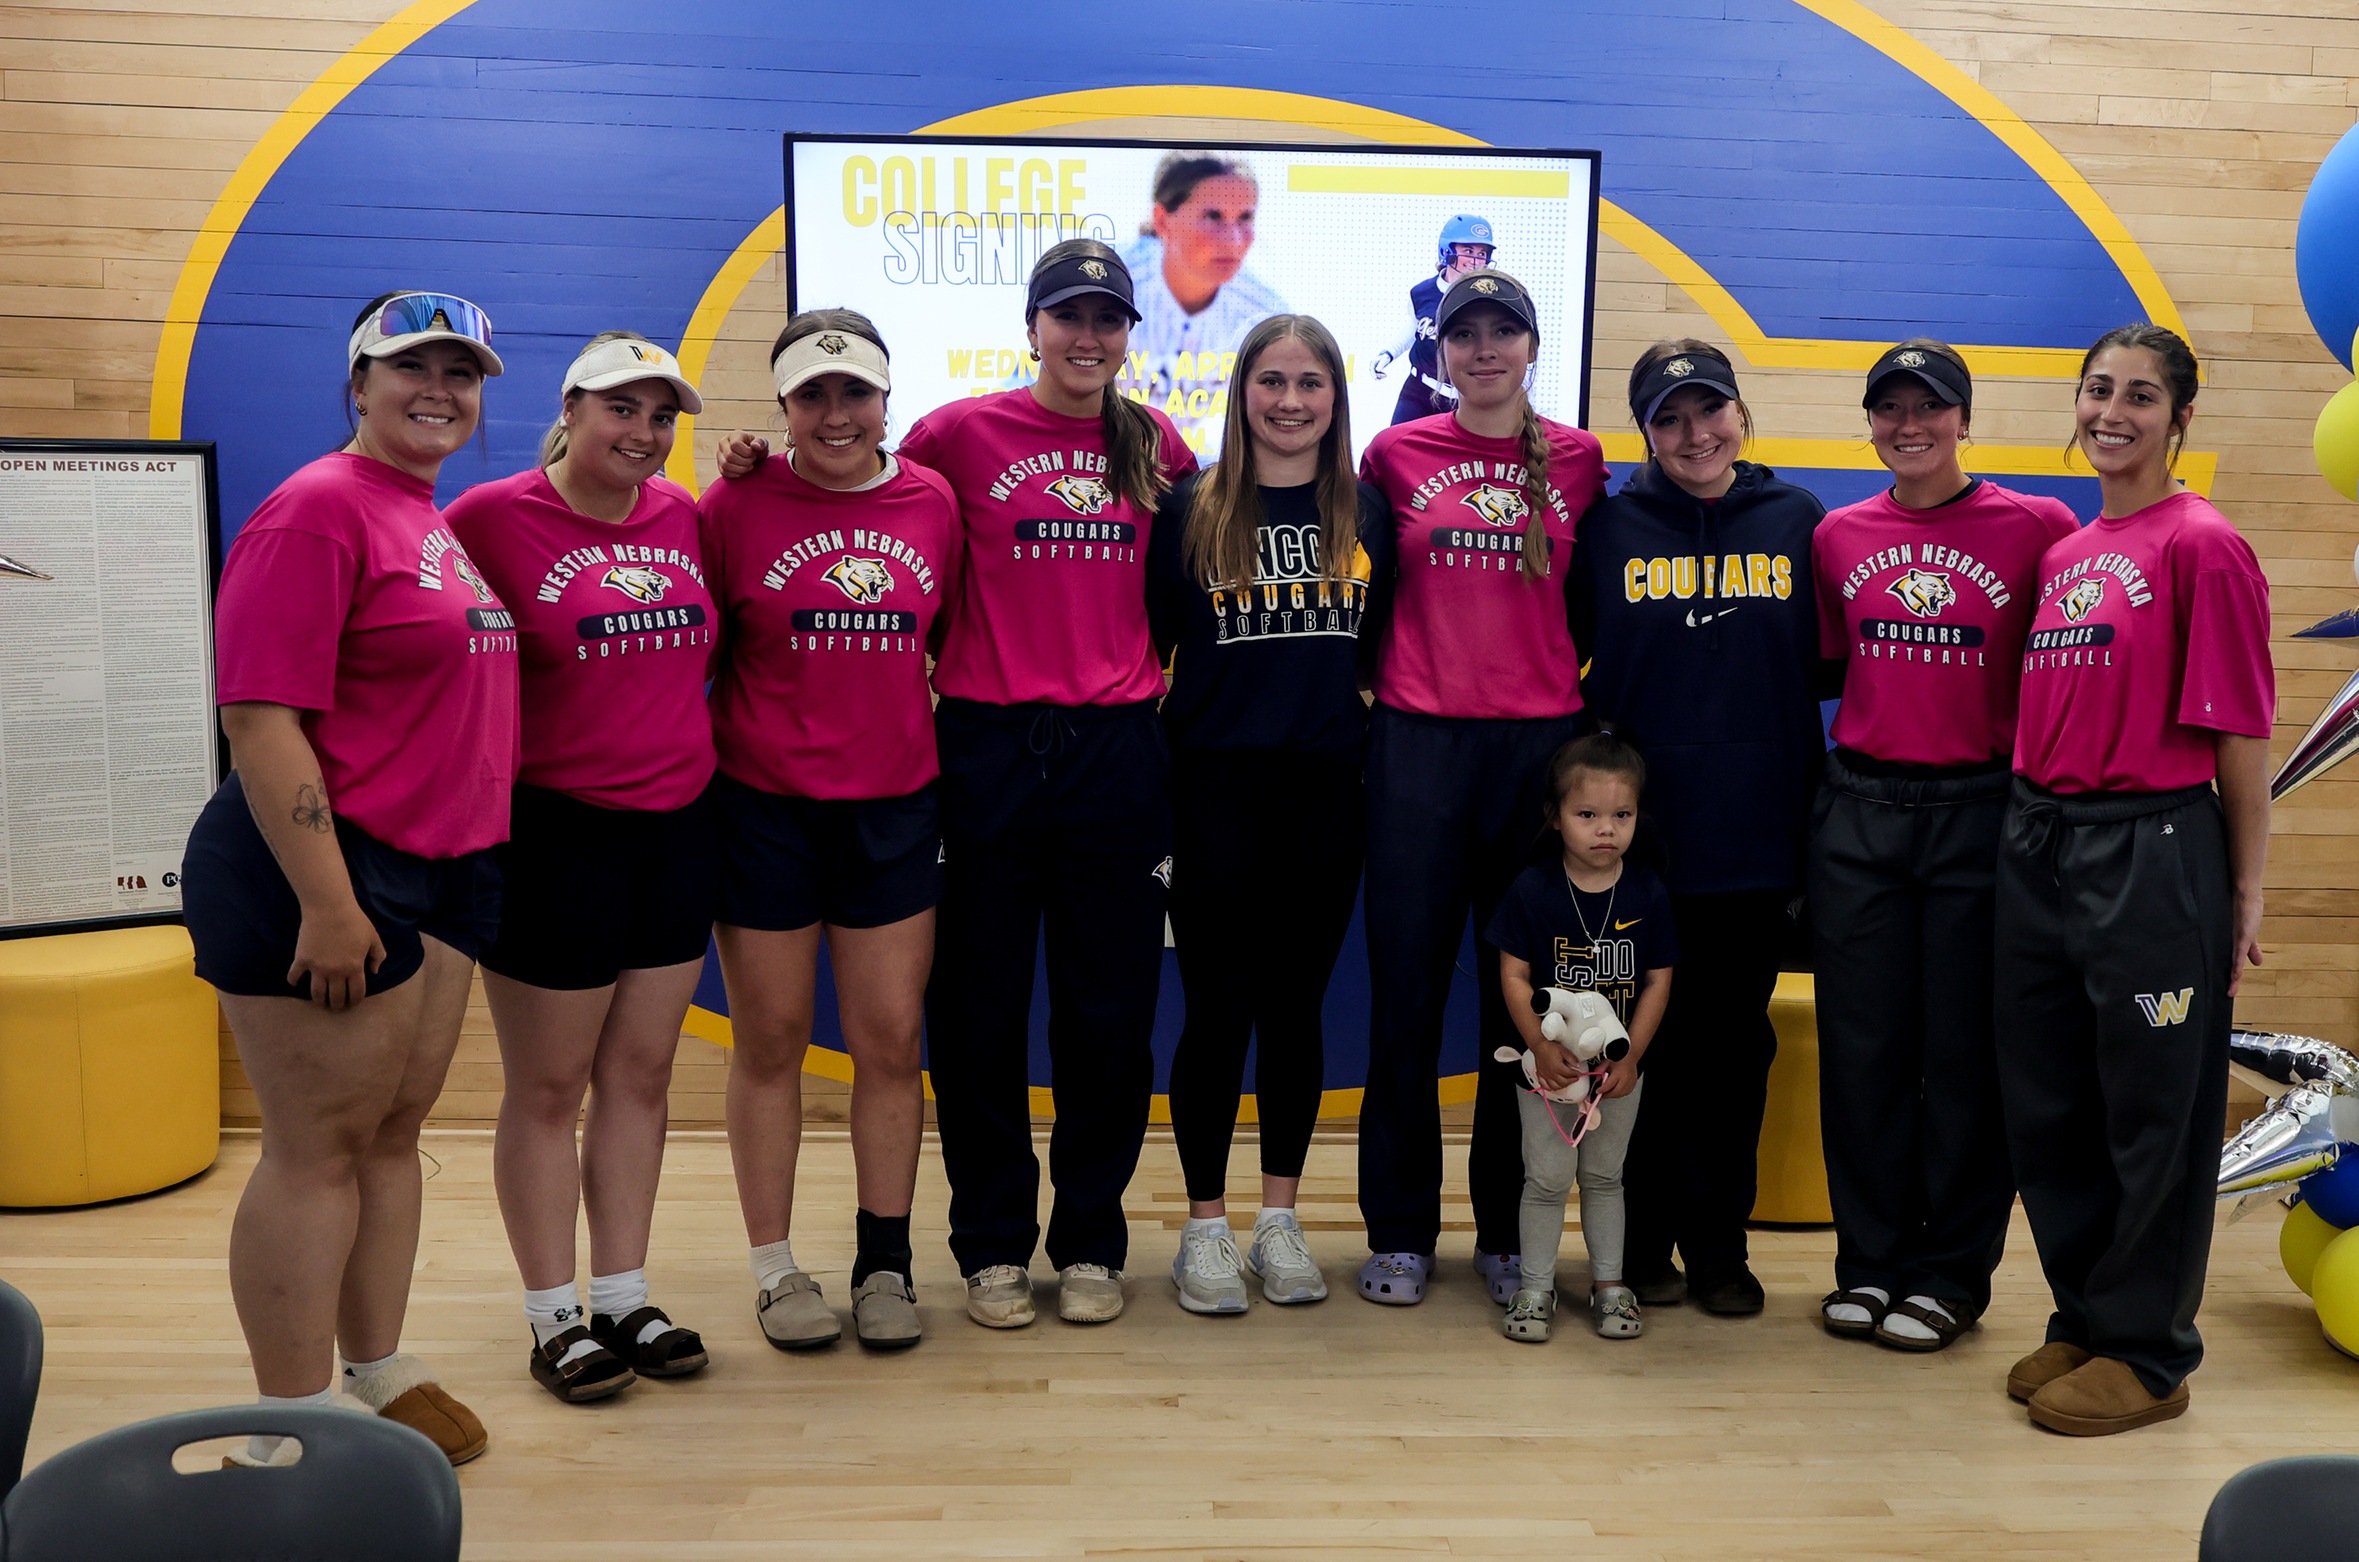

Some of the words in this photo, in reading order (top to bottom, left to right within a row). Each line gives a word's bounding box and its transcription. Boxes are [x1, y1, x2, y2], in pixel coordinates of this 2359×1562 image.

[842, 155, 1087, 229] COLLEGE
[0, 460, 47, 472] OPEN
[53, 461, 140, 472] MEETINGS
[145, 462, 177, 472] ACT
[989, 451, 1065, 502] WESTERN
[1411, 460, 1485, 512] WESTERN
[1494, 463, 1570, 523] NEBSKA
[1038, 522, 1121, 541] COUGARS
[1451, 531, 1523, 551] COUGAR
[763, 529, 845, 591] WESTERN
[854, 529, 935, 595] NEBRASKA
[1013, 545, 1134, 563] SOFTBALL
[1429, 552, 1551, 575] SOFTBAL
[537, 545, 609, 604] WESTERN
[612, 543, 705, 589] NEBRASKA
[1624, 553, 1792, 603] COUGARS
[1842, 543, 1913, 601] WESTERN
[1921, 543, 2012, 610] NEBRASKA
[2039, 557, 2092, 606] STERN
[2093, 552, 2153, 608] NEBRASKA
[1212, 583, 1367, 618] COUGARS
[603, 608, 689, 634] COUGARS
[815, 612, 900, 631] COUGARS
[1218, 609, 1362, 640] SOFTBALL
[1877, 622, 1962, 644] COUGARS
[577, 629, 709, 660] SOFTBALL
[790, 636, 916, 652] SOFTBALL
[2033, 627, 2094, 649] COUGARS
[1859, 642, 1985, 667] SOFTBALL
[2024, 650, 2112, 674] SOFTBALL
[1595, 939, 1635, 981] DO
